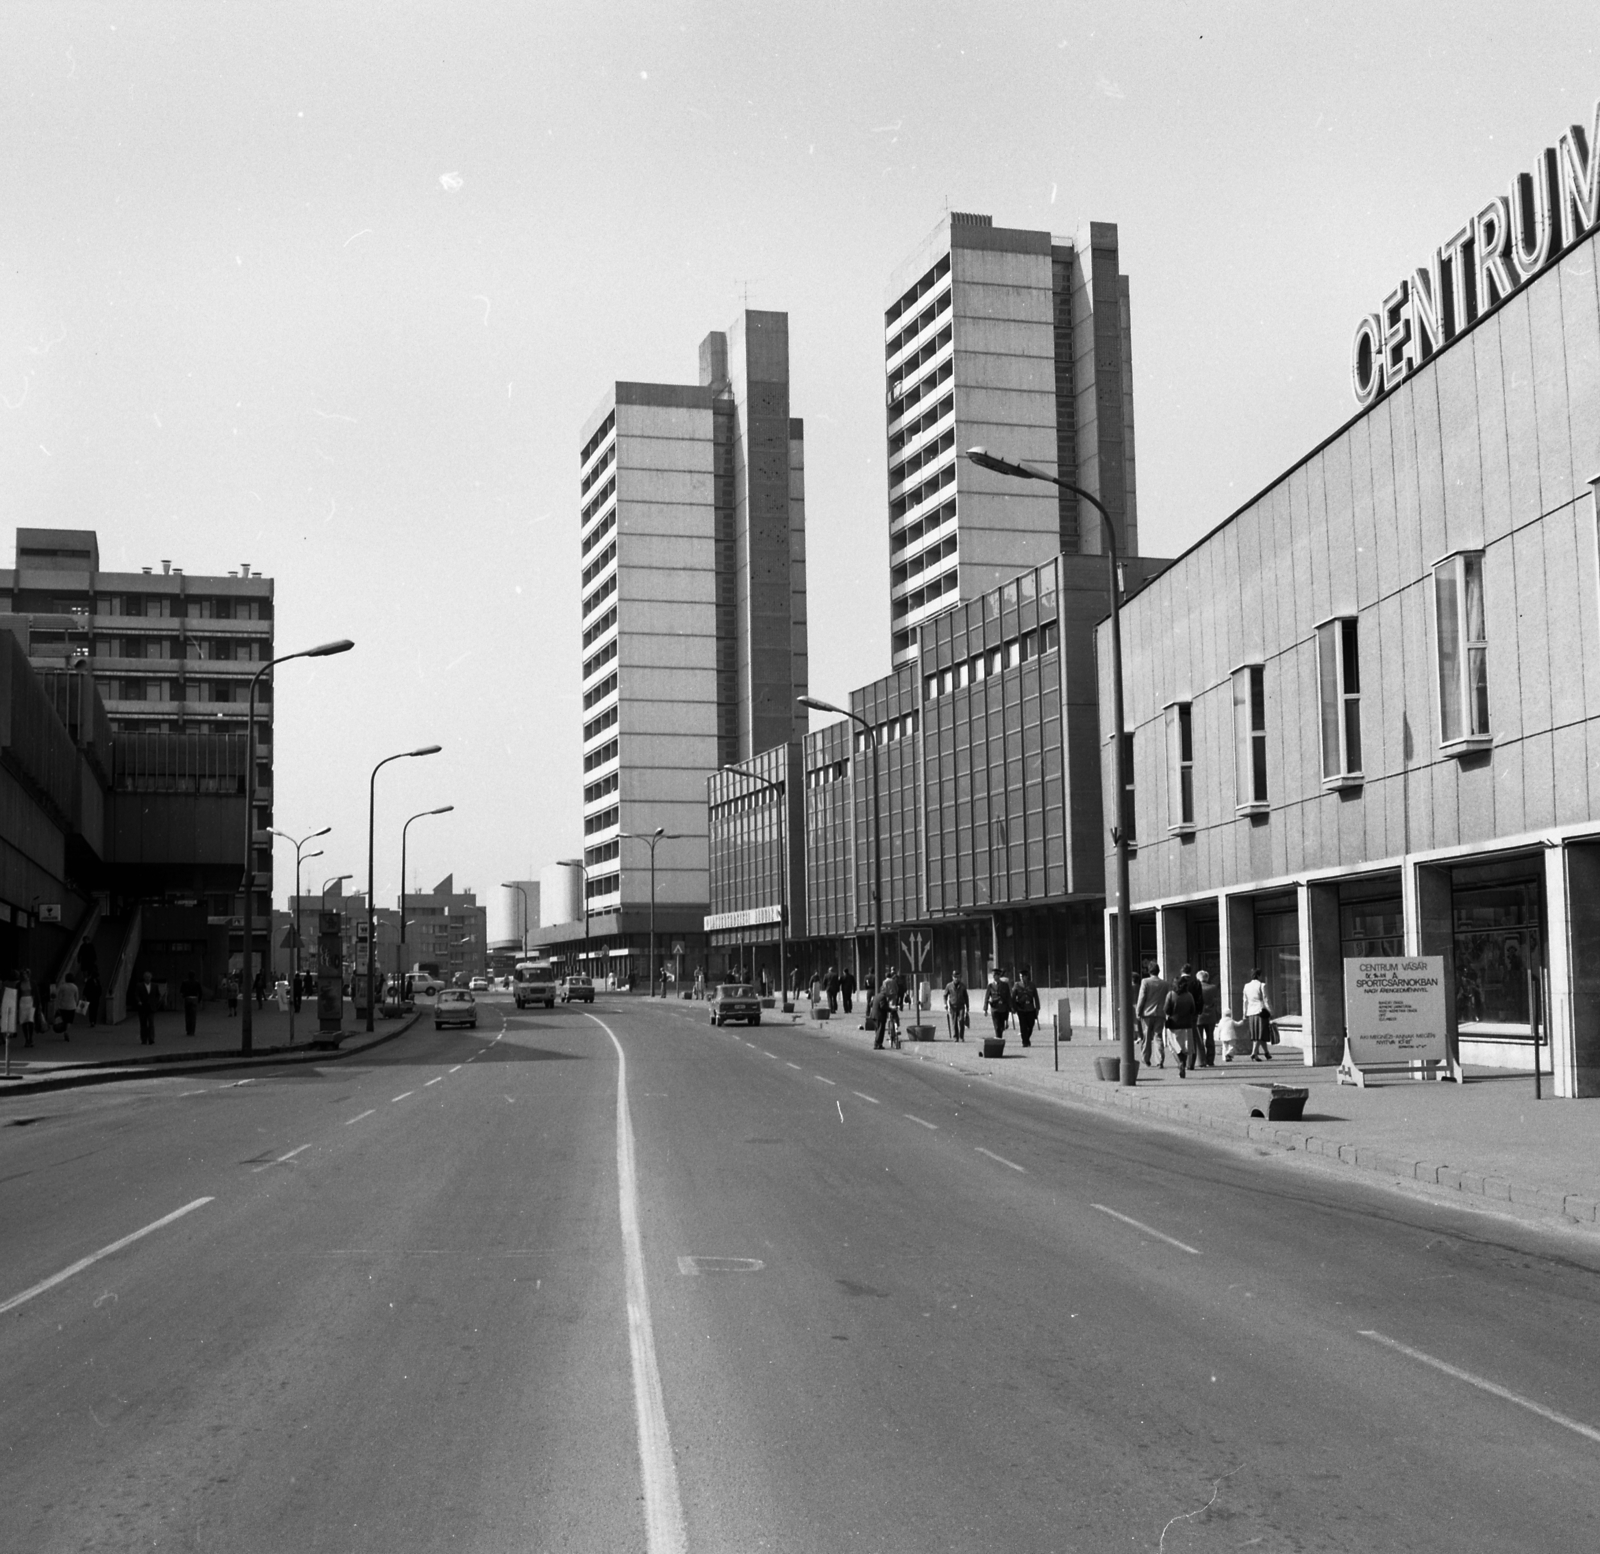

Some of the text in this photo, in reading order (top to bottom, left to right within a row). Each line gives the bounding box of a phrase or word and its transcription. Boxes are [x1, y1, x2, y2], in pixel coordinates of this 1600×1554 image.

[1359, 961, 1428, 972] CENTRUM VÁSÁR
[1356, 978, 1438, 988] SPORTCSARNOKBAN
